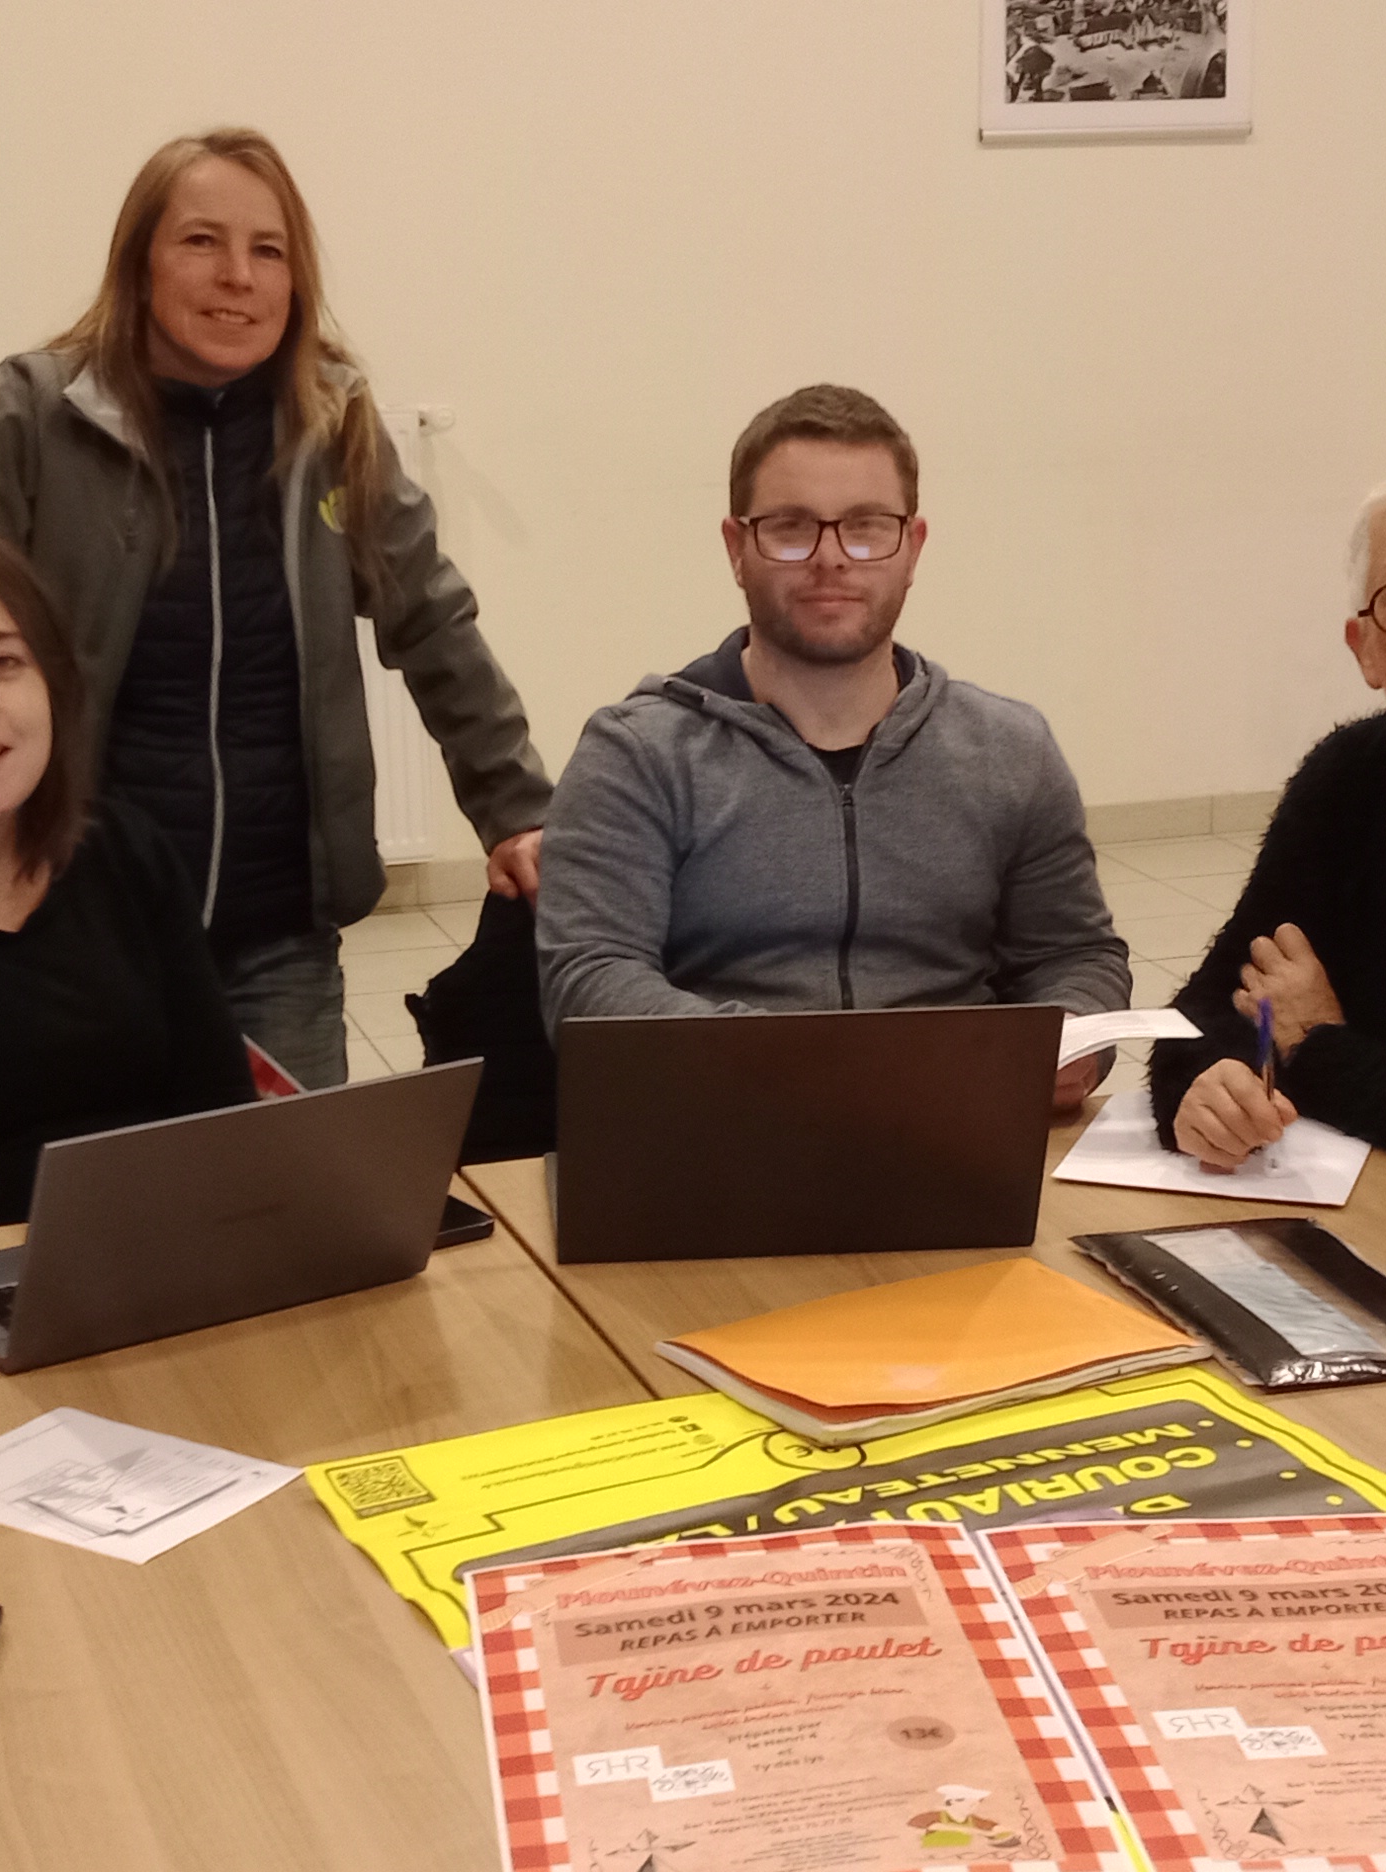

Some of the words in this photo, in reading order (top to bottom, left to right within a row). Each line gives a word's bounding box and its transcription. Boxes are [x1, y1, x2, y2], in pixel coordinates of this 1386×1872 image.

[773, 1422, 1196, 1526] MENNETEAU
[1112, 1587, 1231, 1606] Samedi
[1239, 1588, 1259, 1602] 9
[1268, 1585, 1351, 1601] mars
[574, 1607, 697, 1638] Samedi
[708, 1603, 727, 1620] 9
[733, 1597, 817, 1614] mars
[824, 1591, 901, 1607] 2024
[1163, 1606, 1240, 1621] REPAS
[619, 1629, 700, 1653] REPAS
[729, 1610, 867, 1636] EMPORTER
[1288, 1631, 1346, 1654] de
[733, 1647, 794, 1675] de
[799, 1635, 944, 1672] poulet
[898, 1727, 944, 1742] 13€
